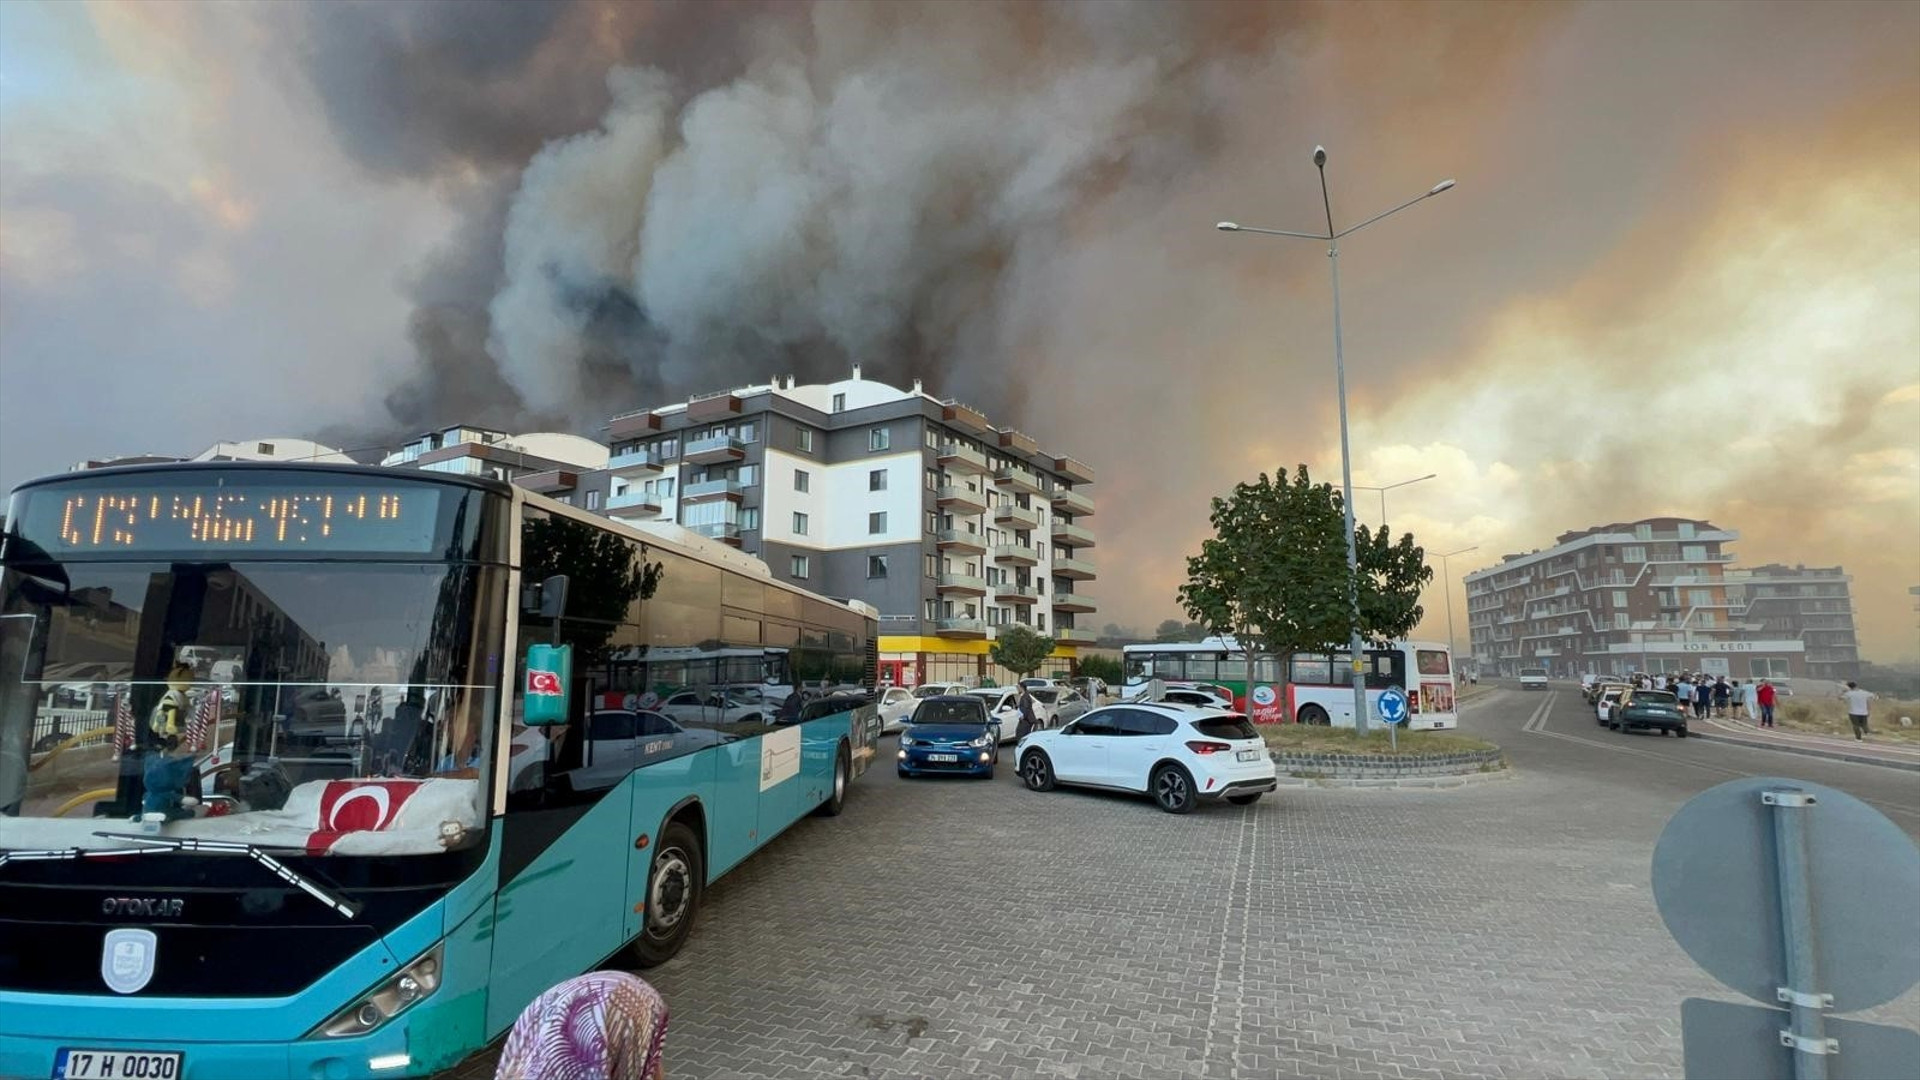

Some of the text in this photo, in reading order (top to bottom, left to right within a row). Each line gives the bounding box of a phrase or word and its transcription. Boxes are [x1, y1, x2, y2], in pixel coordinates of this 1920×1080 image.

[102, 897, 184, 917] OTOKAR
[71, 1053, 175, 1079] 17 H 0030
